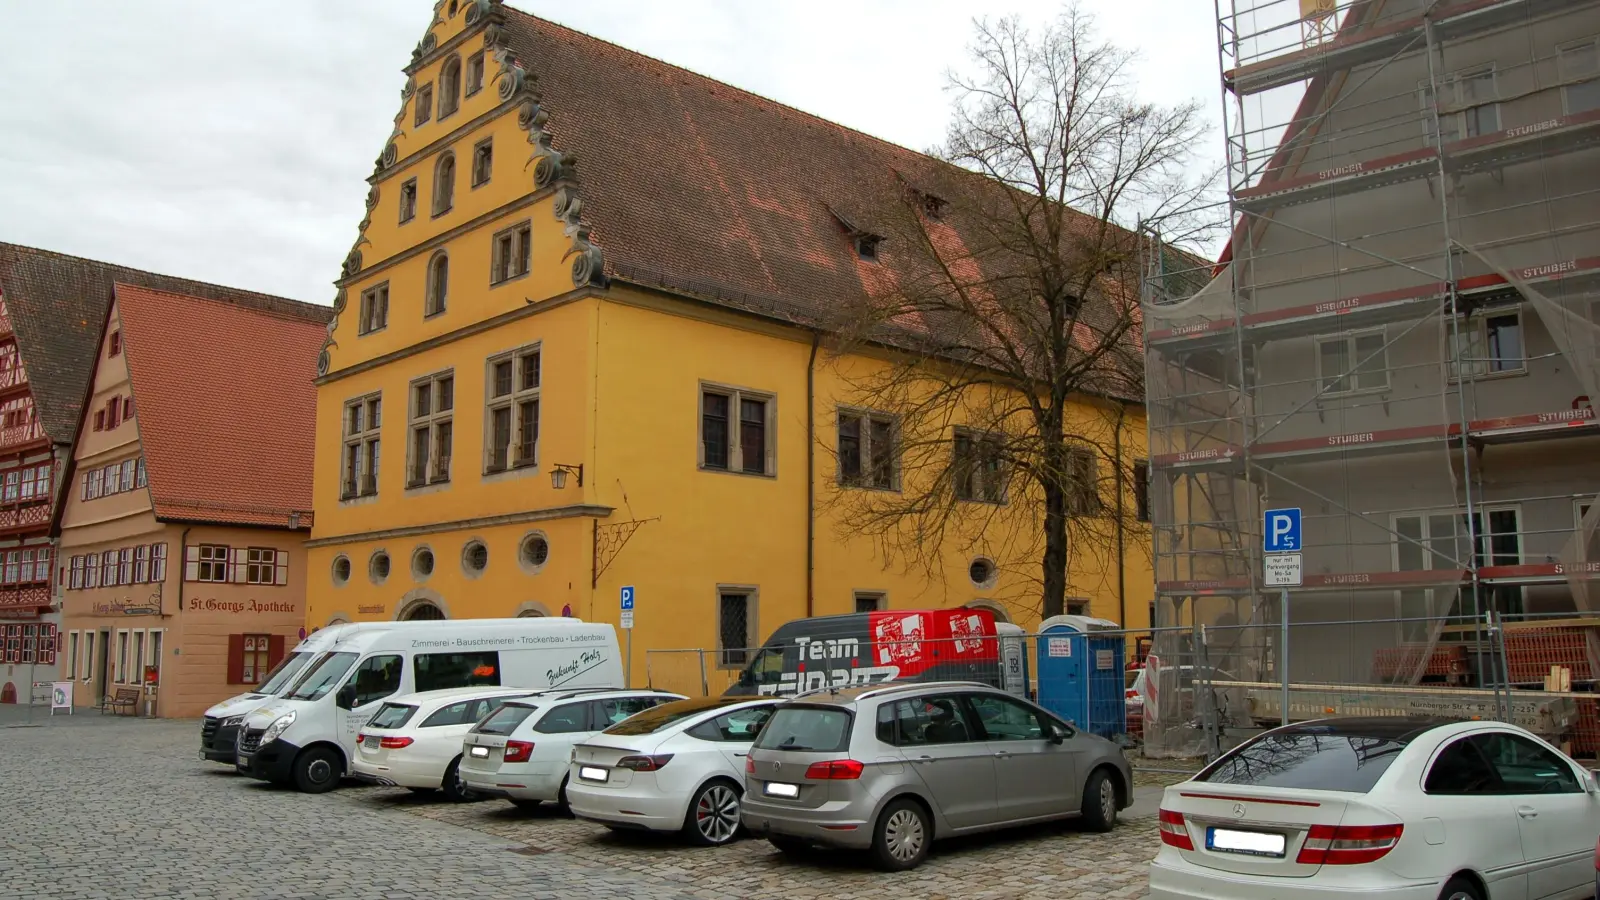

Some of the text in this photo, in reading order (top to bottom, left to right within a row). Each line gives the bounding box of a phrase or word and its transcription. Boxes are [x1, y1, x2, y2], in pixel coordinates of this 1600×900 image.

[1507, 119, 1557, 137] STUIBER
[1523, 260, 1576, 278] STUIBER
[1538, 410, 1591, 422] STUIBER
[1328, 433, 1374, 445] STUIBER
[1179, 449, 1218, 461] STUIBER
[1273, 515, 1292, 546] P
[247, 598, 295, 613] Apotheke
[623, 589, 630, 607] P
[411, 634, 606, 648] Zimmerei Bauschreinerei Trockenbau Ladenbau
[795, 636, 859, 661] Team
[546, 649, 601, 685] Zukunft Holz
[1410, 701, 1449, 710] Nürnberger
